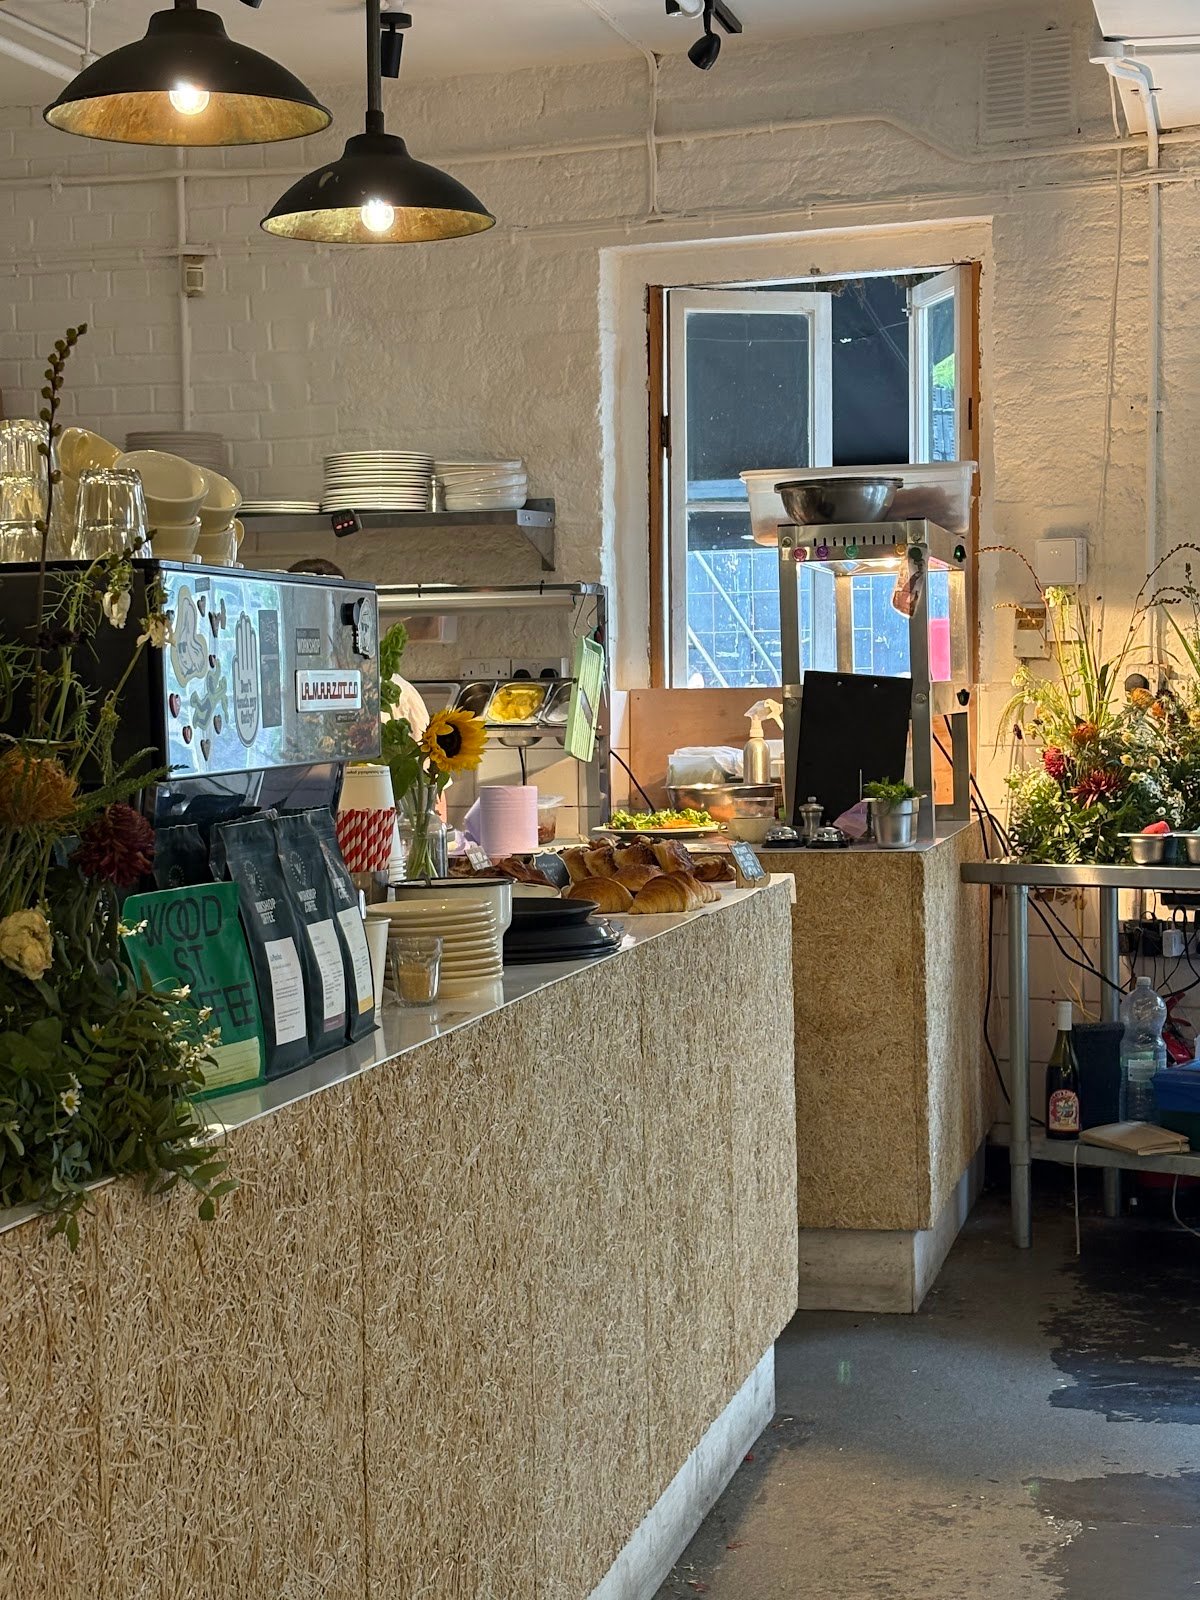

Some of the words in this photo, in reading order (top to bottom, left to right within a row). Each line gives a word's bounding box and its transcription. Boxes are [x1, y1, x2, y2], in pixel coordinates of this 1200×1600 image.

[297, 638, 320, 654] WORKSHOP
[140, 895, 222, 945] WOOD
[174, 945, 215, 988] ST.
